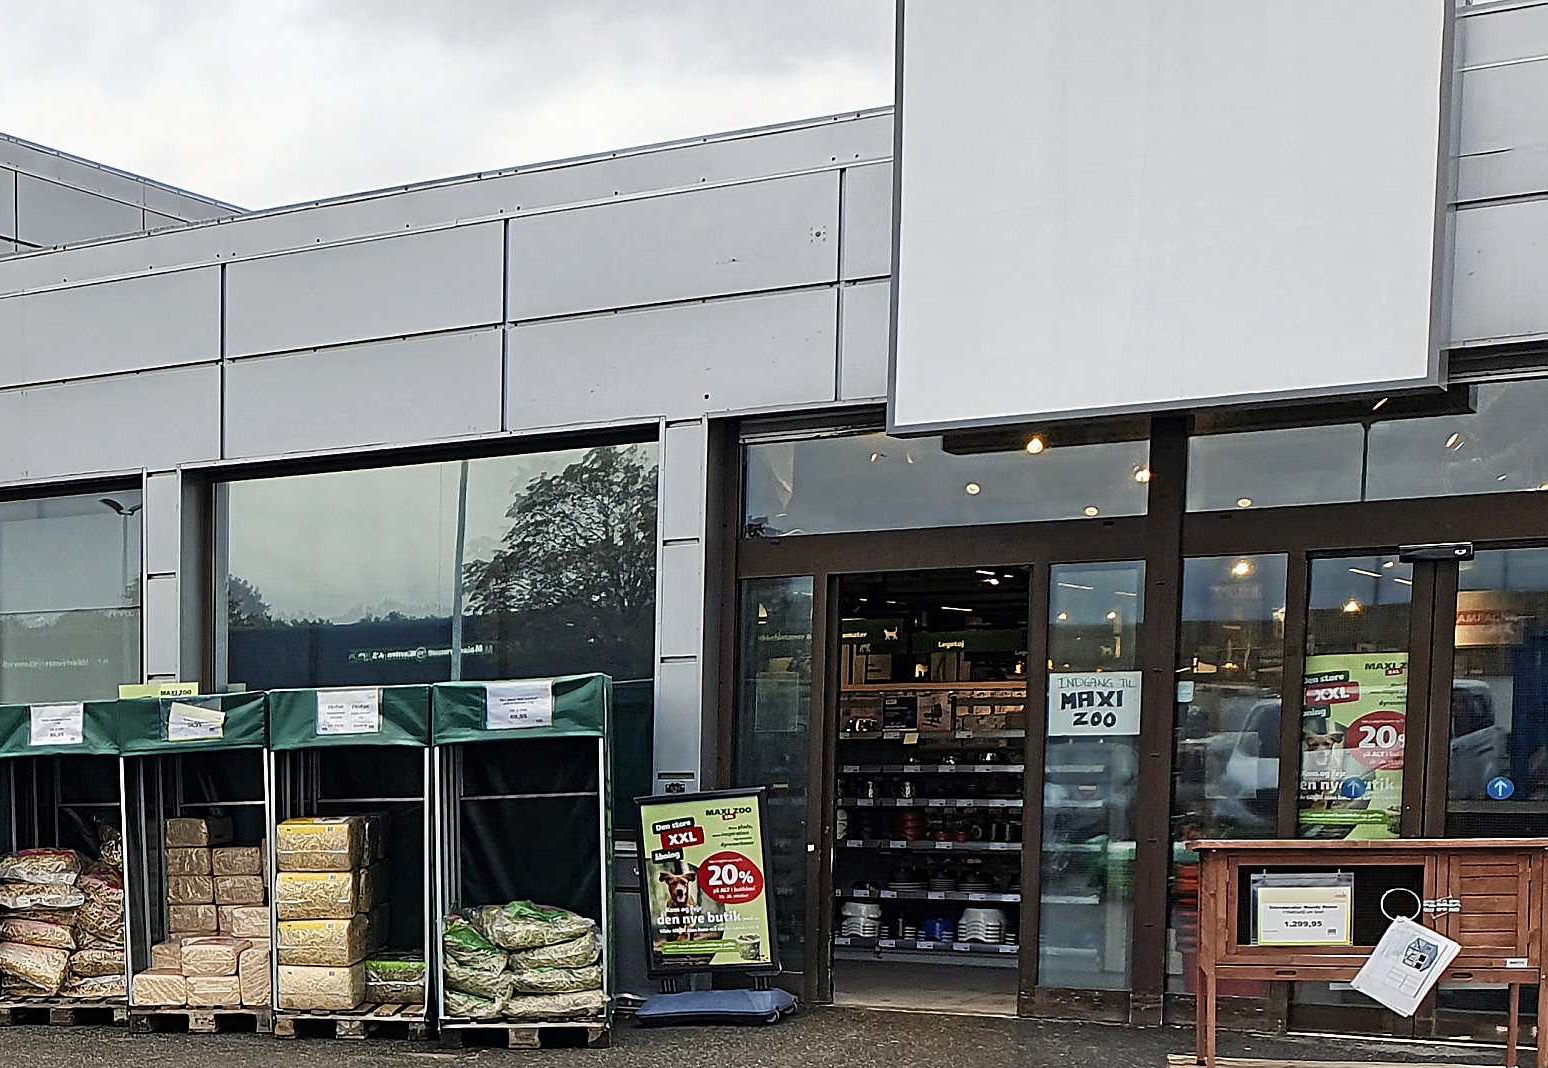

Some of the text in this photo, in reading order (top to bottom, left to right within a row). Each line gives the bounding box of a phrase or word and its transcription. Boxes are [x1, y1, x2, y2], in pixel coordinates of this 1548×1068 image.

[1058, 677, 1138, 689] INDGANG TIL
[1061, 690, 1123, 711] MAXI
[1315, 687, 1350, 701] XXL
[1073, 711, 1117, 728] ZOO
[705, 808, 732, 816] MAXI
[672, 820, 691, 828] store
[668, 832, 698, 846] XXL
[707, 864, 754, 886] 20%
[657, 911, 741, 927] den nye butik
